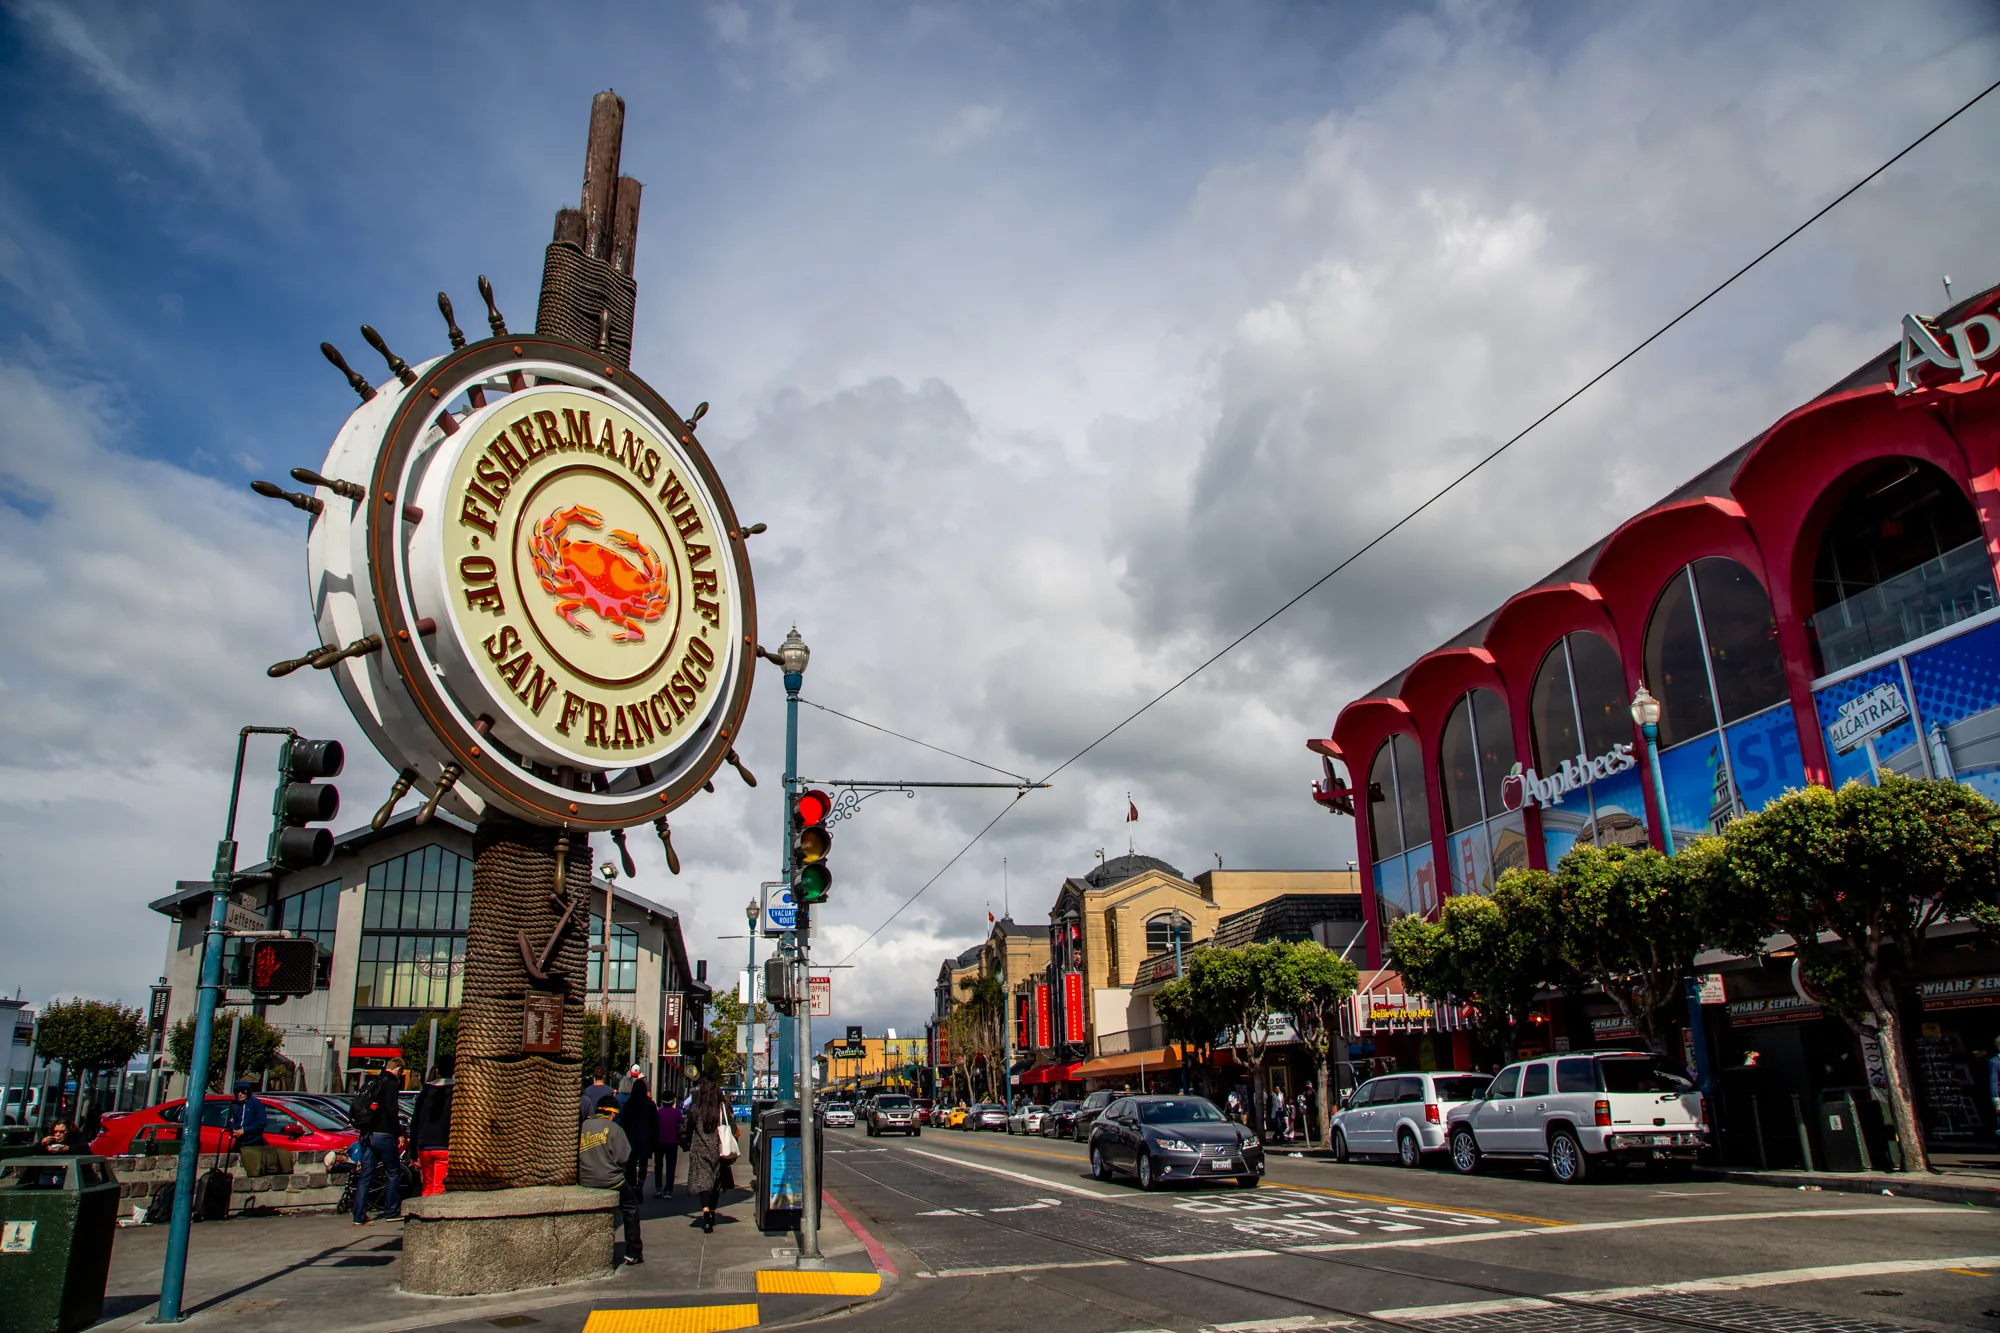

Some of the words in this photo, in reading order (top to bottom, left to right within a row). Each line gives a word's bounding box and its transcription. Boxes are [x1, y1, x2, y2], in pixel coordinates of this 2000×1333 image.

[1894, 313, 2000, 396] Ap
[458, 407, 661, 539] FISHERMANS
[656, 468, 720, 629] WHARF
[459, 555, 506, 614] OF
[482, 624, 557, 714] SAN
[554, 635, 716, 749] FRANCISCO
[1840, 689, 1875, 715] VIEW
[1832, 691, 1896, 742] ALCATRAZ
[1524, 742, 1635, 809] Applebee's
[1737, 721, 1799, 792] SF
[228, 909, 265, 930] Jefferson
[810, 985, 829, 993] TOPPING
[1923, 980, 1973, 994] WHARF
[1977, 976, 2000, 988] CEN
[1370, 1009, 1398, 1019] Believe
[1400, 1009, 1407, 1018] It
[1417, 1008, 1434, 1018] Not!
[1594, 1018, 1620, 1029] WHARF
[1731, 1000, 1766, 1013] WHARF
[834, 1047, 865, 1058] Radissn
